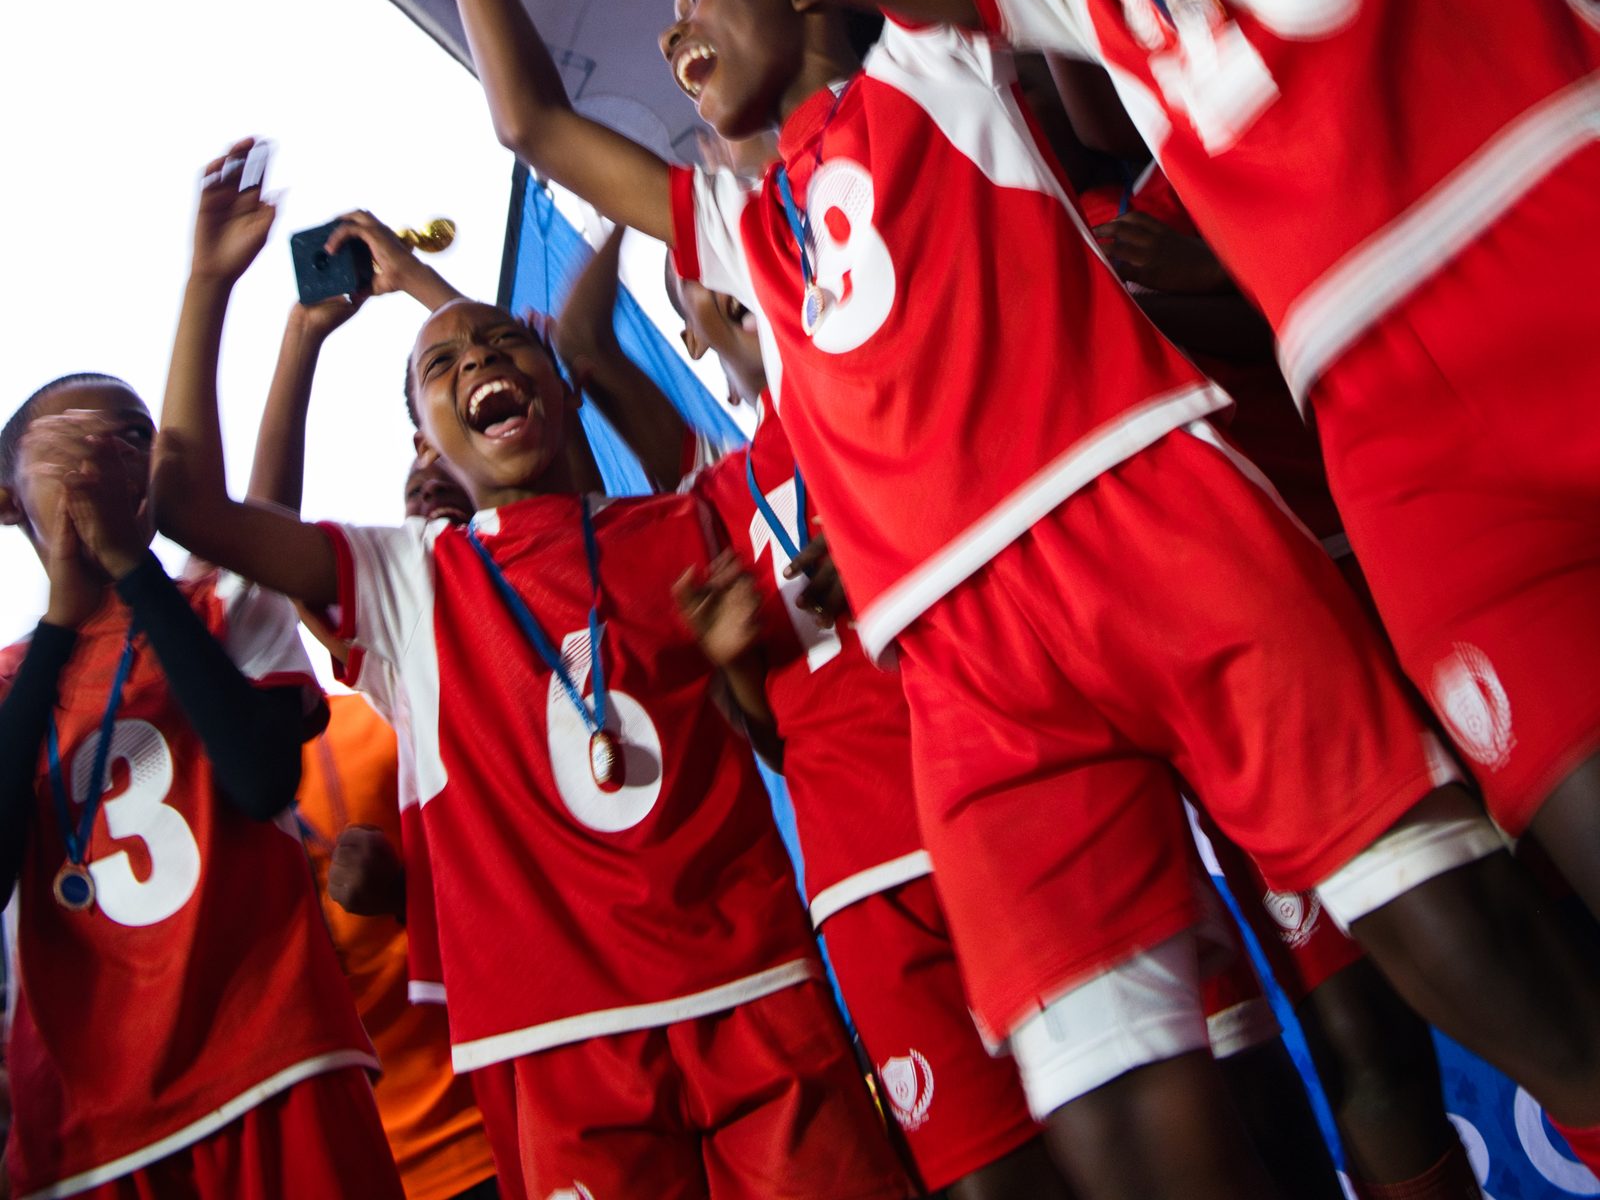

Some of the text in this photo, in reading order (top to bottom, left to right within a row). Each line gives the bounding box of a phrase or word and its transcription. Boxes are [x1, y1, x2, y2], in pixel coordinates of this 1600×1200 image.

[798, 156, 896, 354] 8
[71, 718, 200, 927] 3
[546, 620, 663, 833] 6
